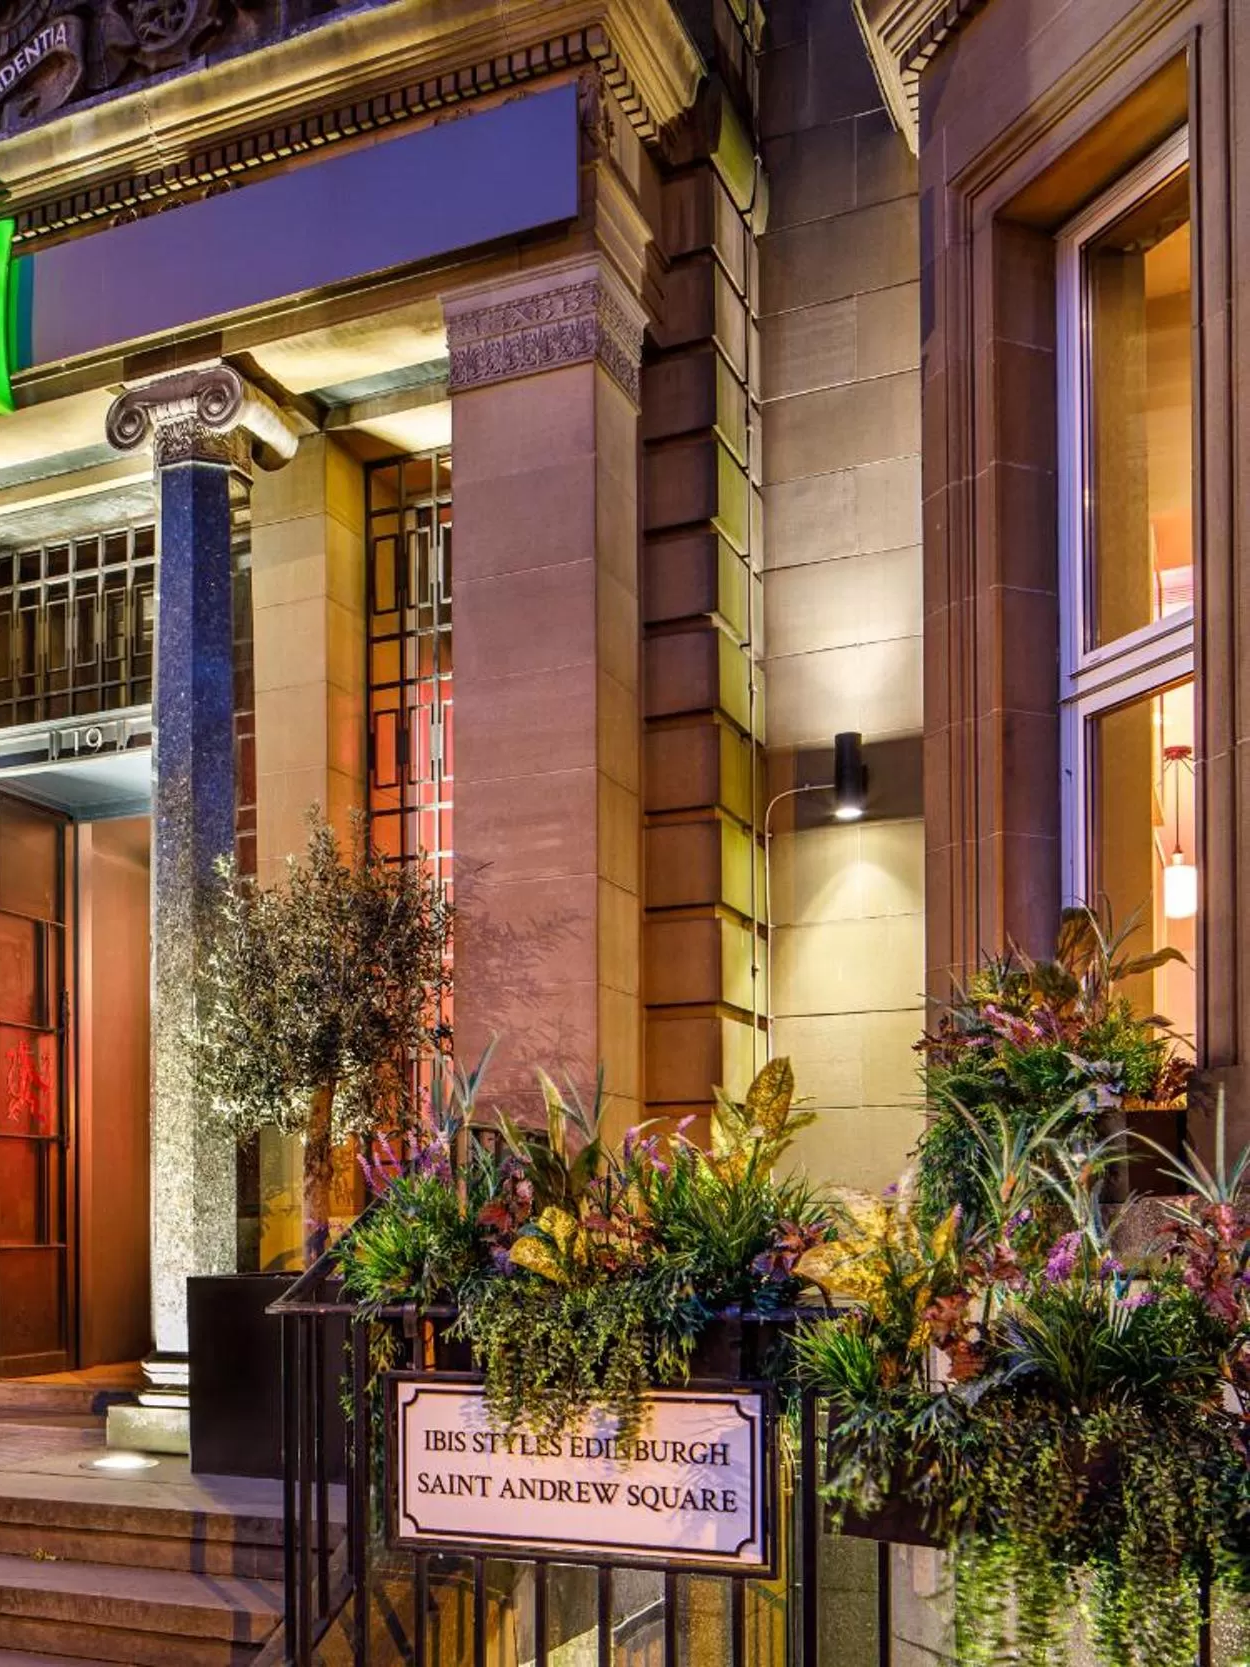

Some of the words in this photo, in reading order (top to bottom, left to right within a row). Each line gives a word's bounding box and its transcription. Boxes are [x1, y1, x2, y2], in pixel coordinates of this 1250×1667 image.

[424, 1430, 467, 1452] IBIS
[472, 1432, 562, 1457] STYLES
[417, 1473, 492, 1498] SAINT
[500, 1478, 619, 1505] ANDREW
[627, 1485, 737, 1513] SQUARE
